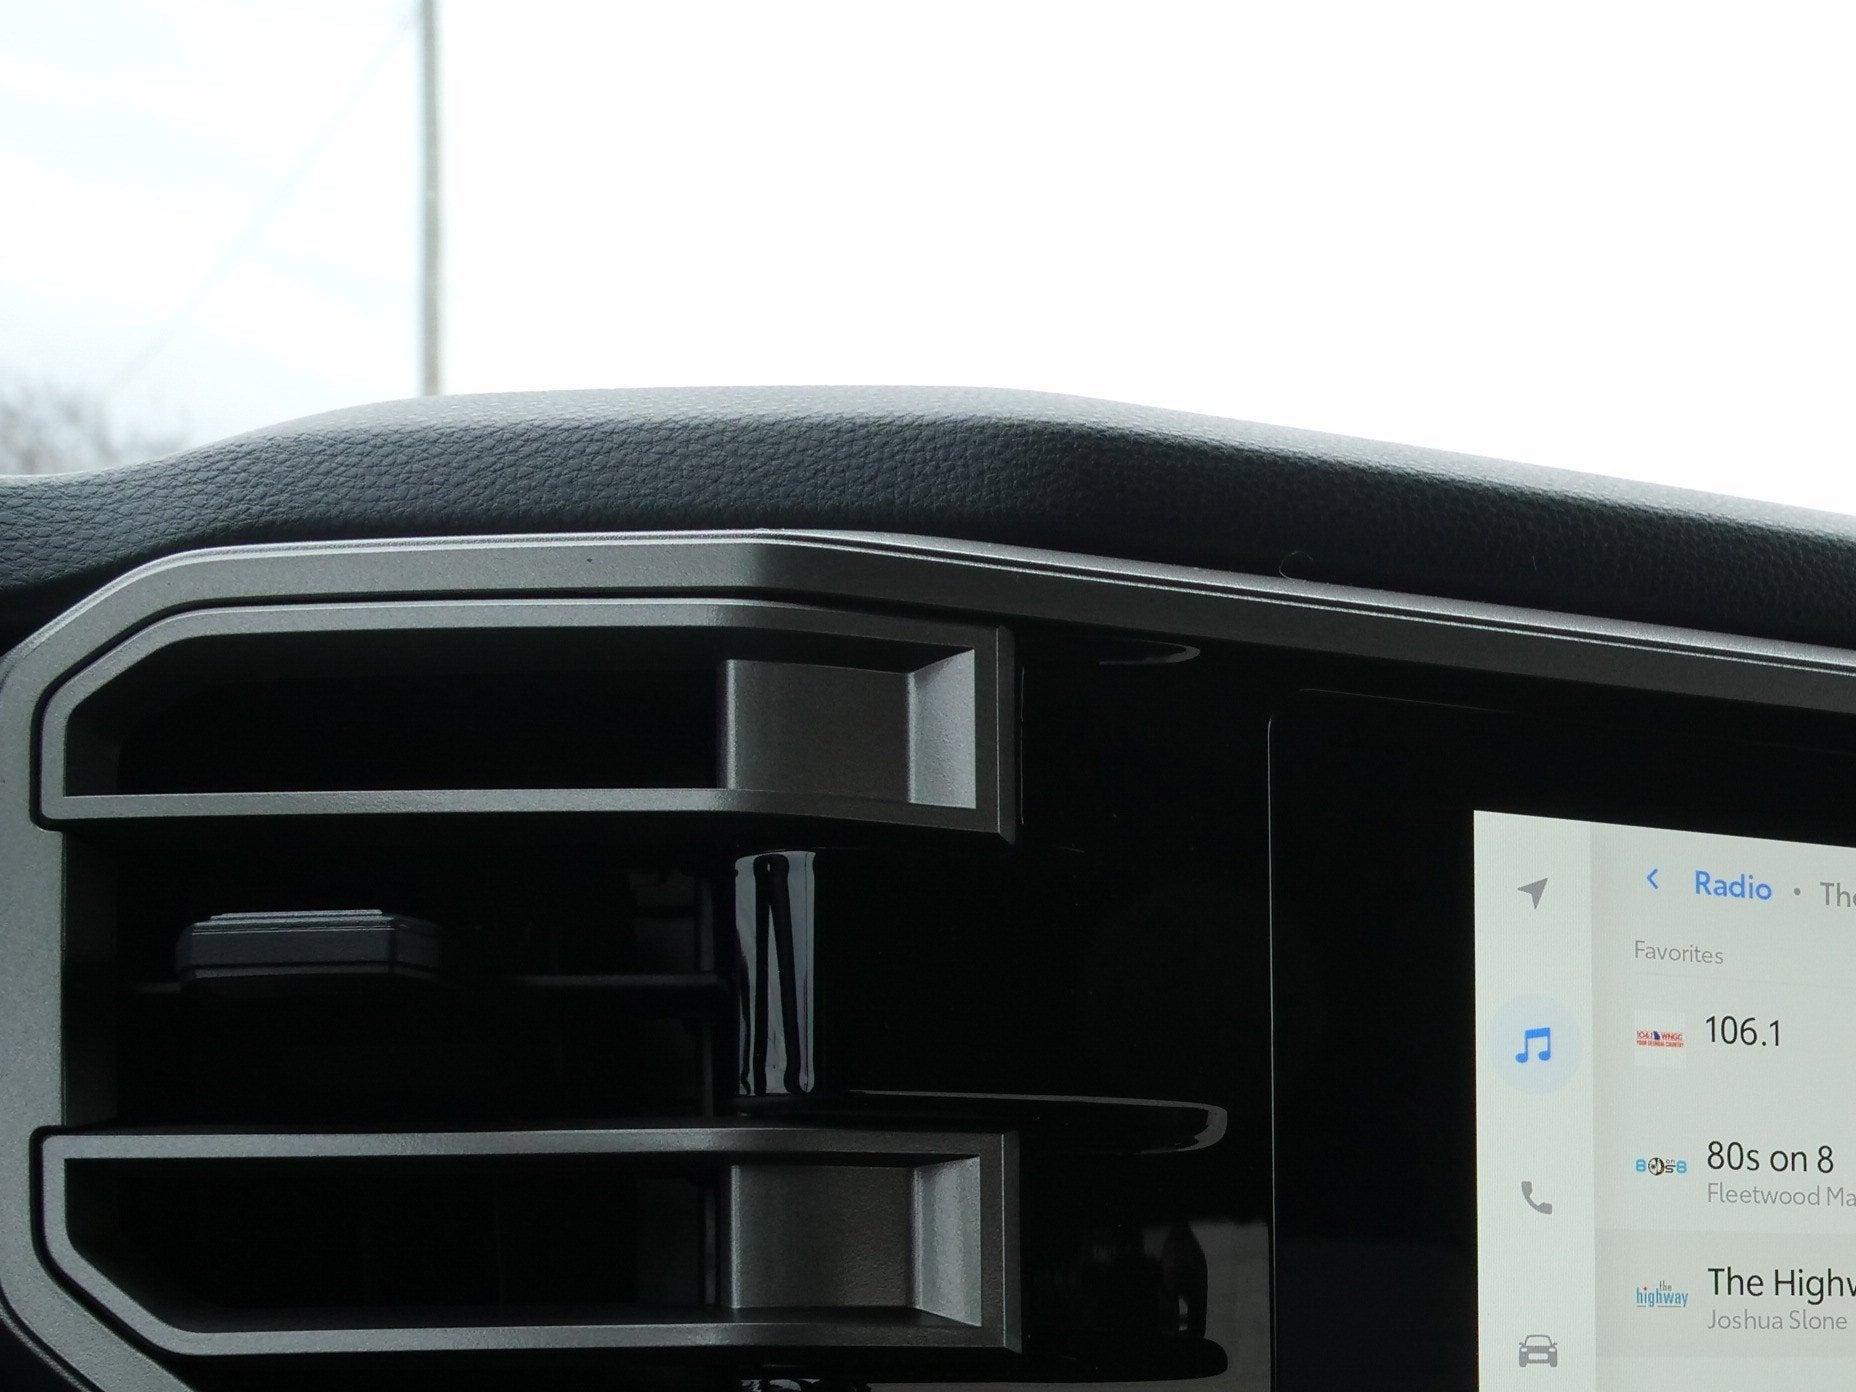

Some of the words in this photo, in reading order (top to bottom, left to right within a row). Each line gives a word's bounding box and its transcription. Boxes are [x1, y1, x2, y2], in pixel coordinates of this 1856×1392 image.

[1694, 869, 1772, 901] Radio
[1634, 940, 1724, 965] Favorites
[1705, 1015, 1782, 1047] 106.1
[1706, 1141, 1760, 1173] 80s
[1770, 1150, 1808, 1173] on
[1817, 1146, 1835, 1174] 8
[1707, 1182, 1821, 1207] Fleetwood
[1660, 1280, 1672, 1291] the
[1707, 1267, 1764, 1297] The
[1636, 1287, 1688, 1307] highway
[1707, 1309, 1784, 1331] Joshua
[1789, 1310, 1848, 1331] Slone
